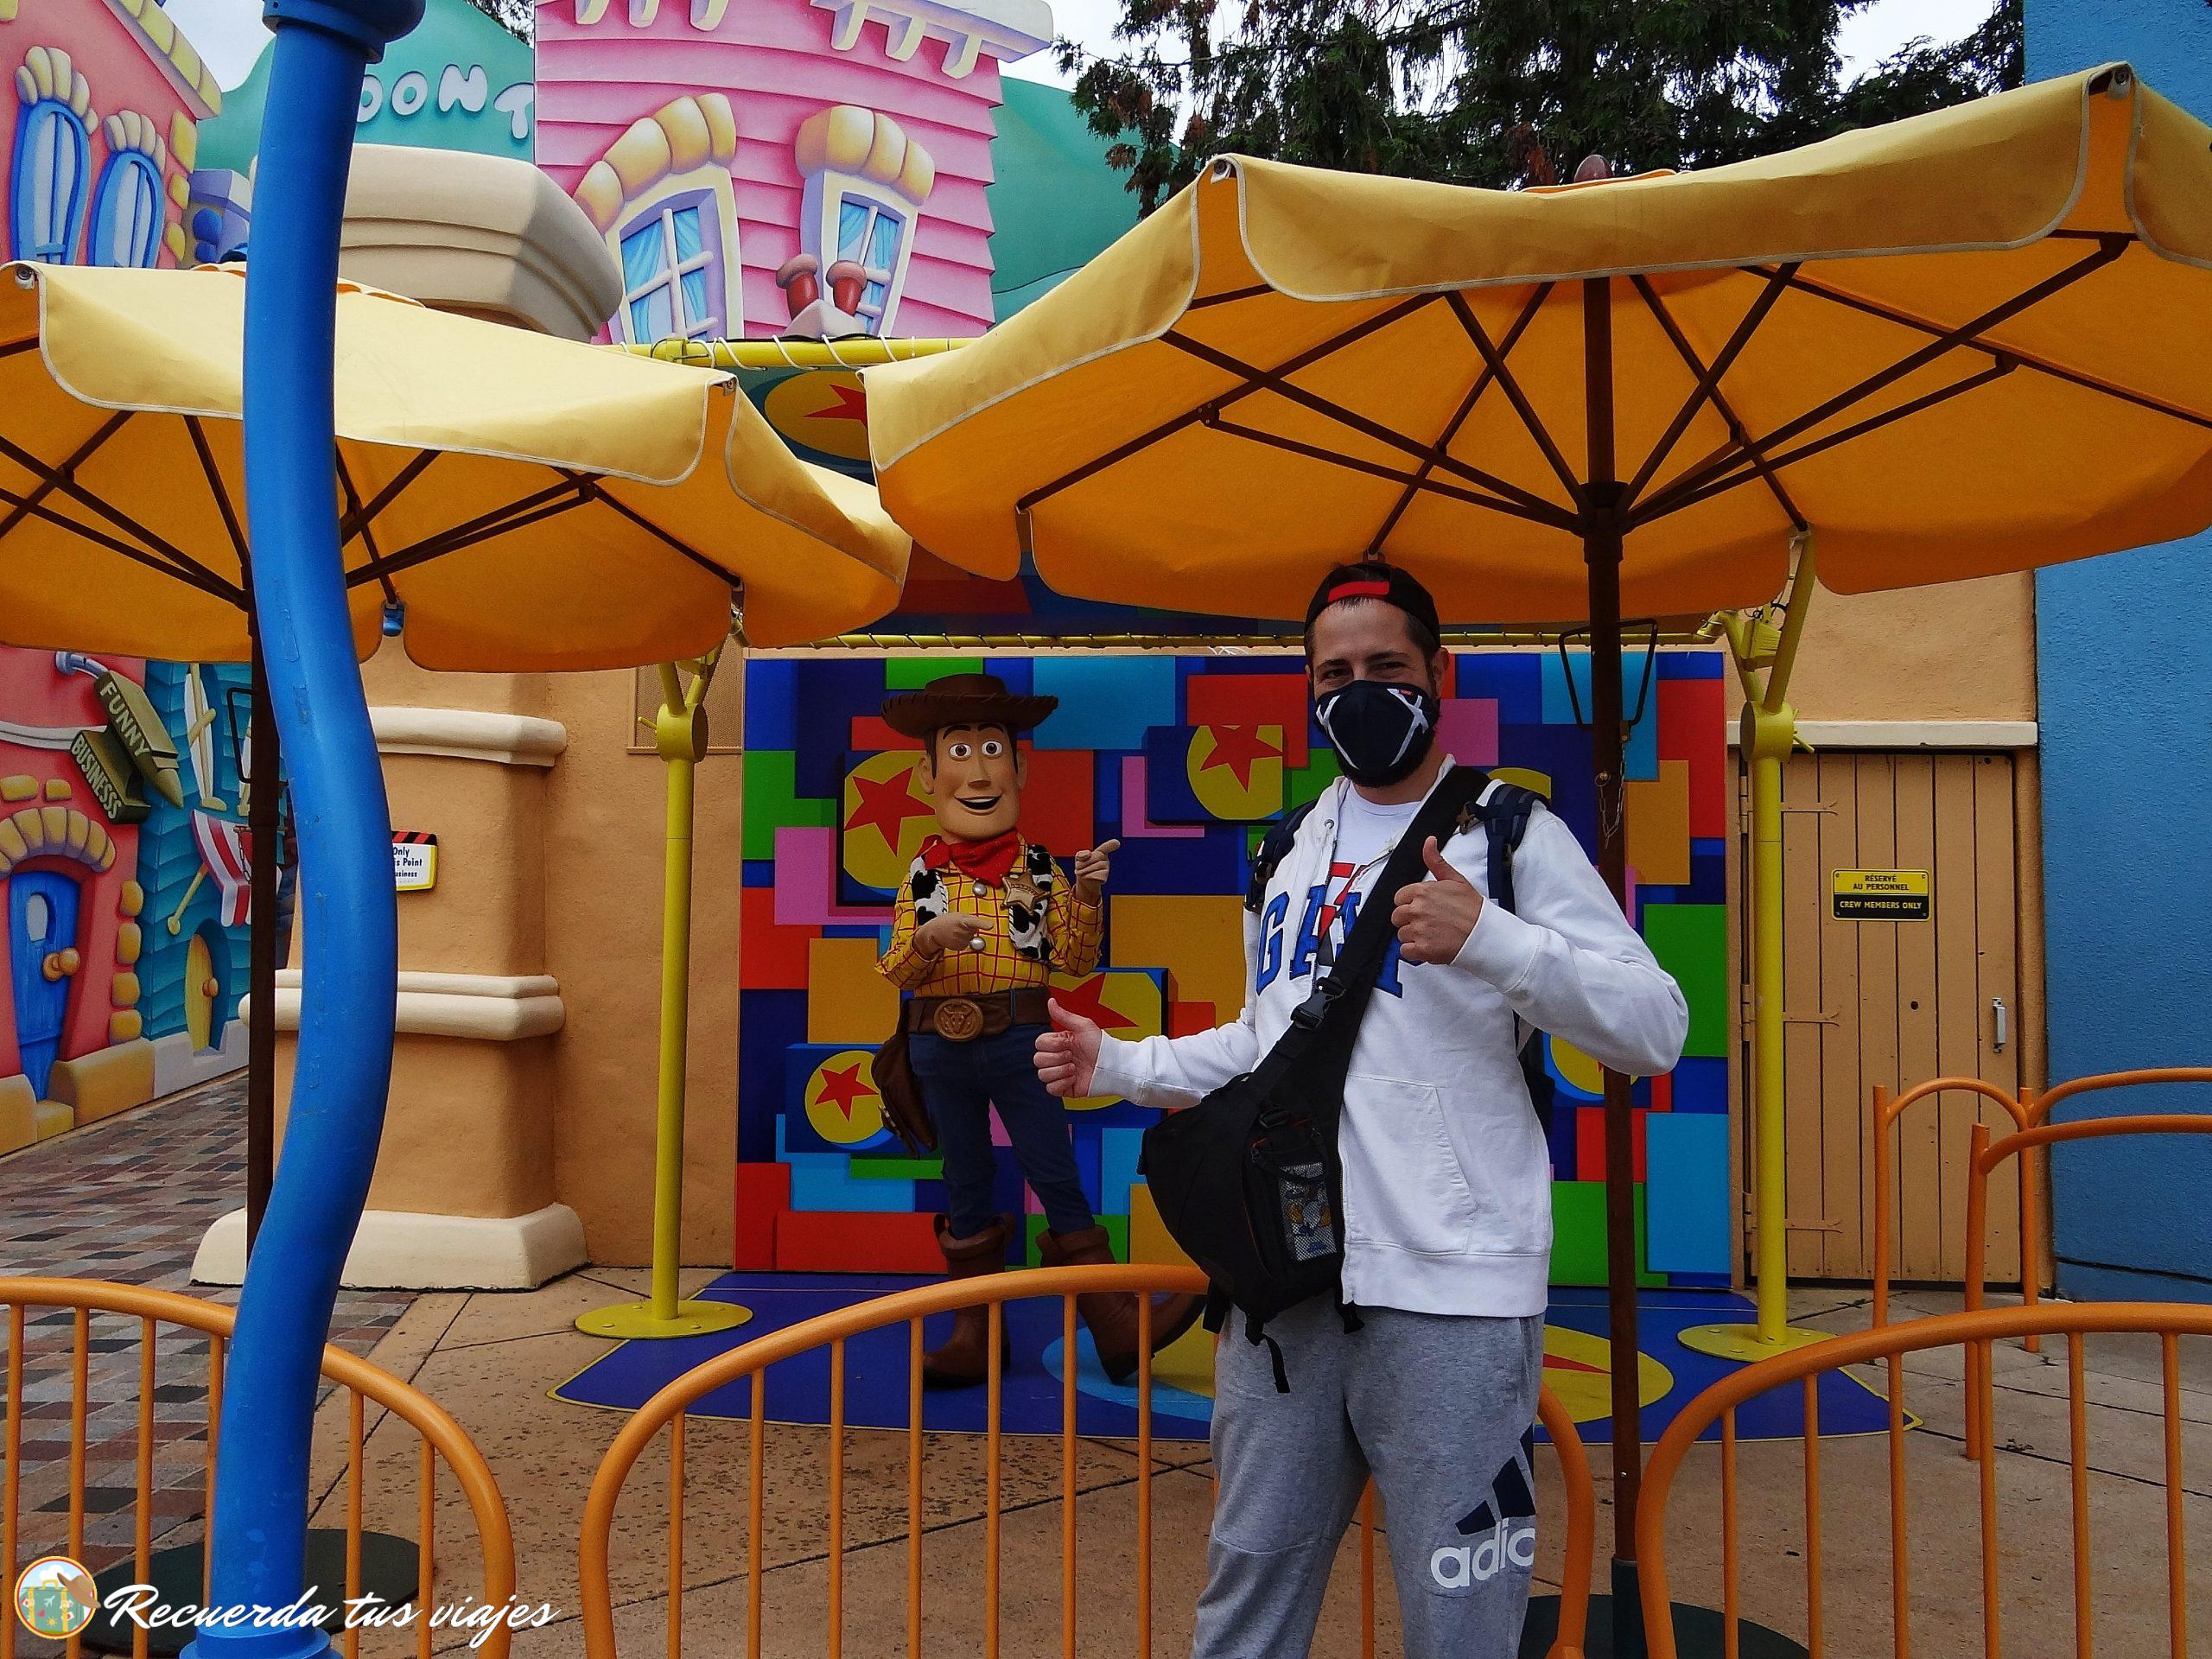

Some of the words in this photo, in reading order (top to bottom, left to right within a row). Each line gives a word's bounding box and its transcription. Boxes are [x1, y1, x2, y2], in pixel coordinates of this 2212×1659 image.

[99, 681, 150, 757] FUNNY
[403, 857, 423, 867] Point
[1865, 873, 1897, 882] RÉSERVÉ
